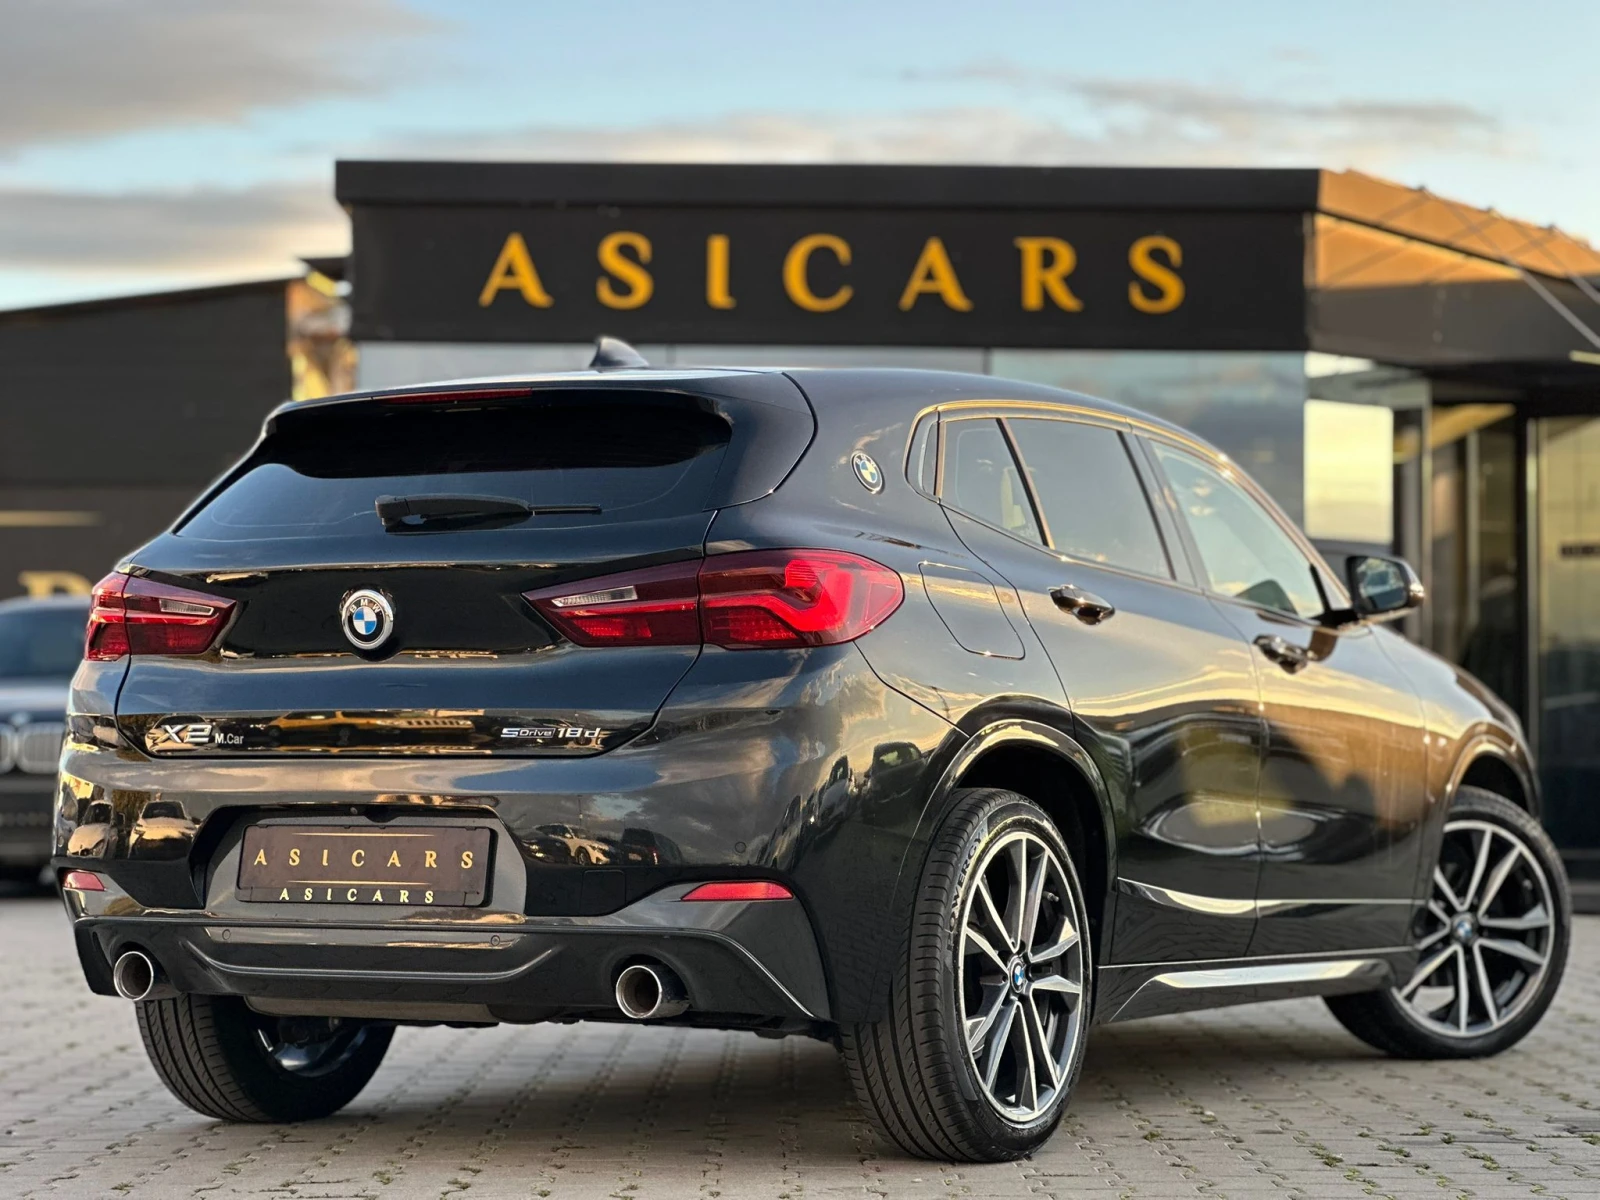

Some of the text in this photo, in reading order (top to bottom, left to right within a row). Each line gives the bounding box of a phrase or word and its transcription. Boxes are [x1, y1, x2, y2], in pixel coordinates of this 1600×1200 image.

[479, 232, 1187, 314] ASICARS
[350, 598, 381, 613] BMW
[153, 724, 213, 743] X2
[557, 727, 601, 738] 18d
[253, 848, 474, 870] ASICARS
[279, 887, 434, 904] ASICARS
